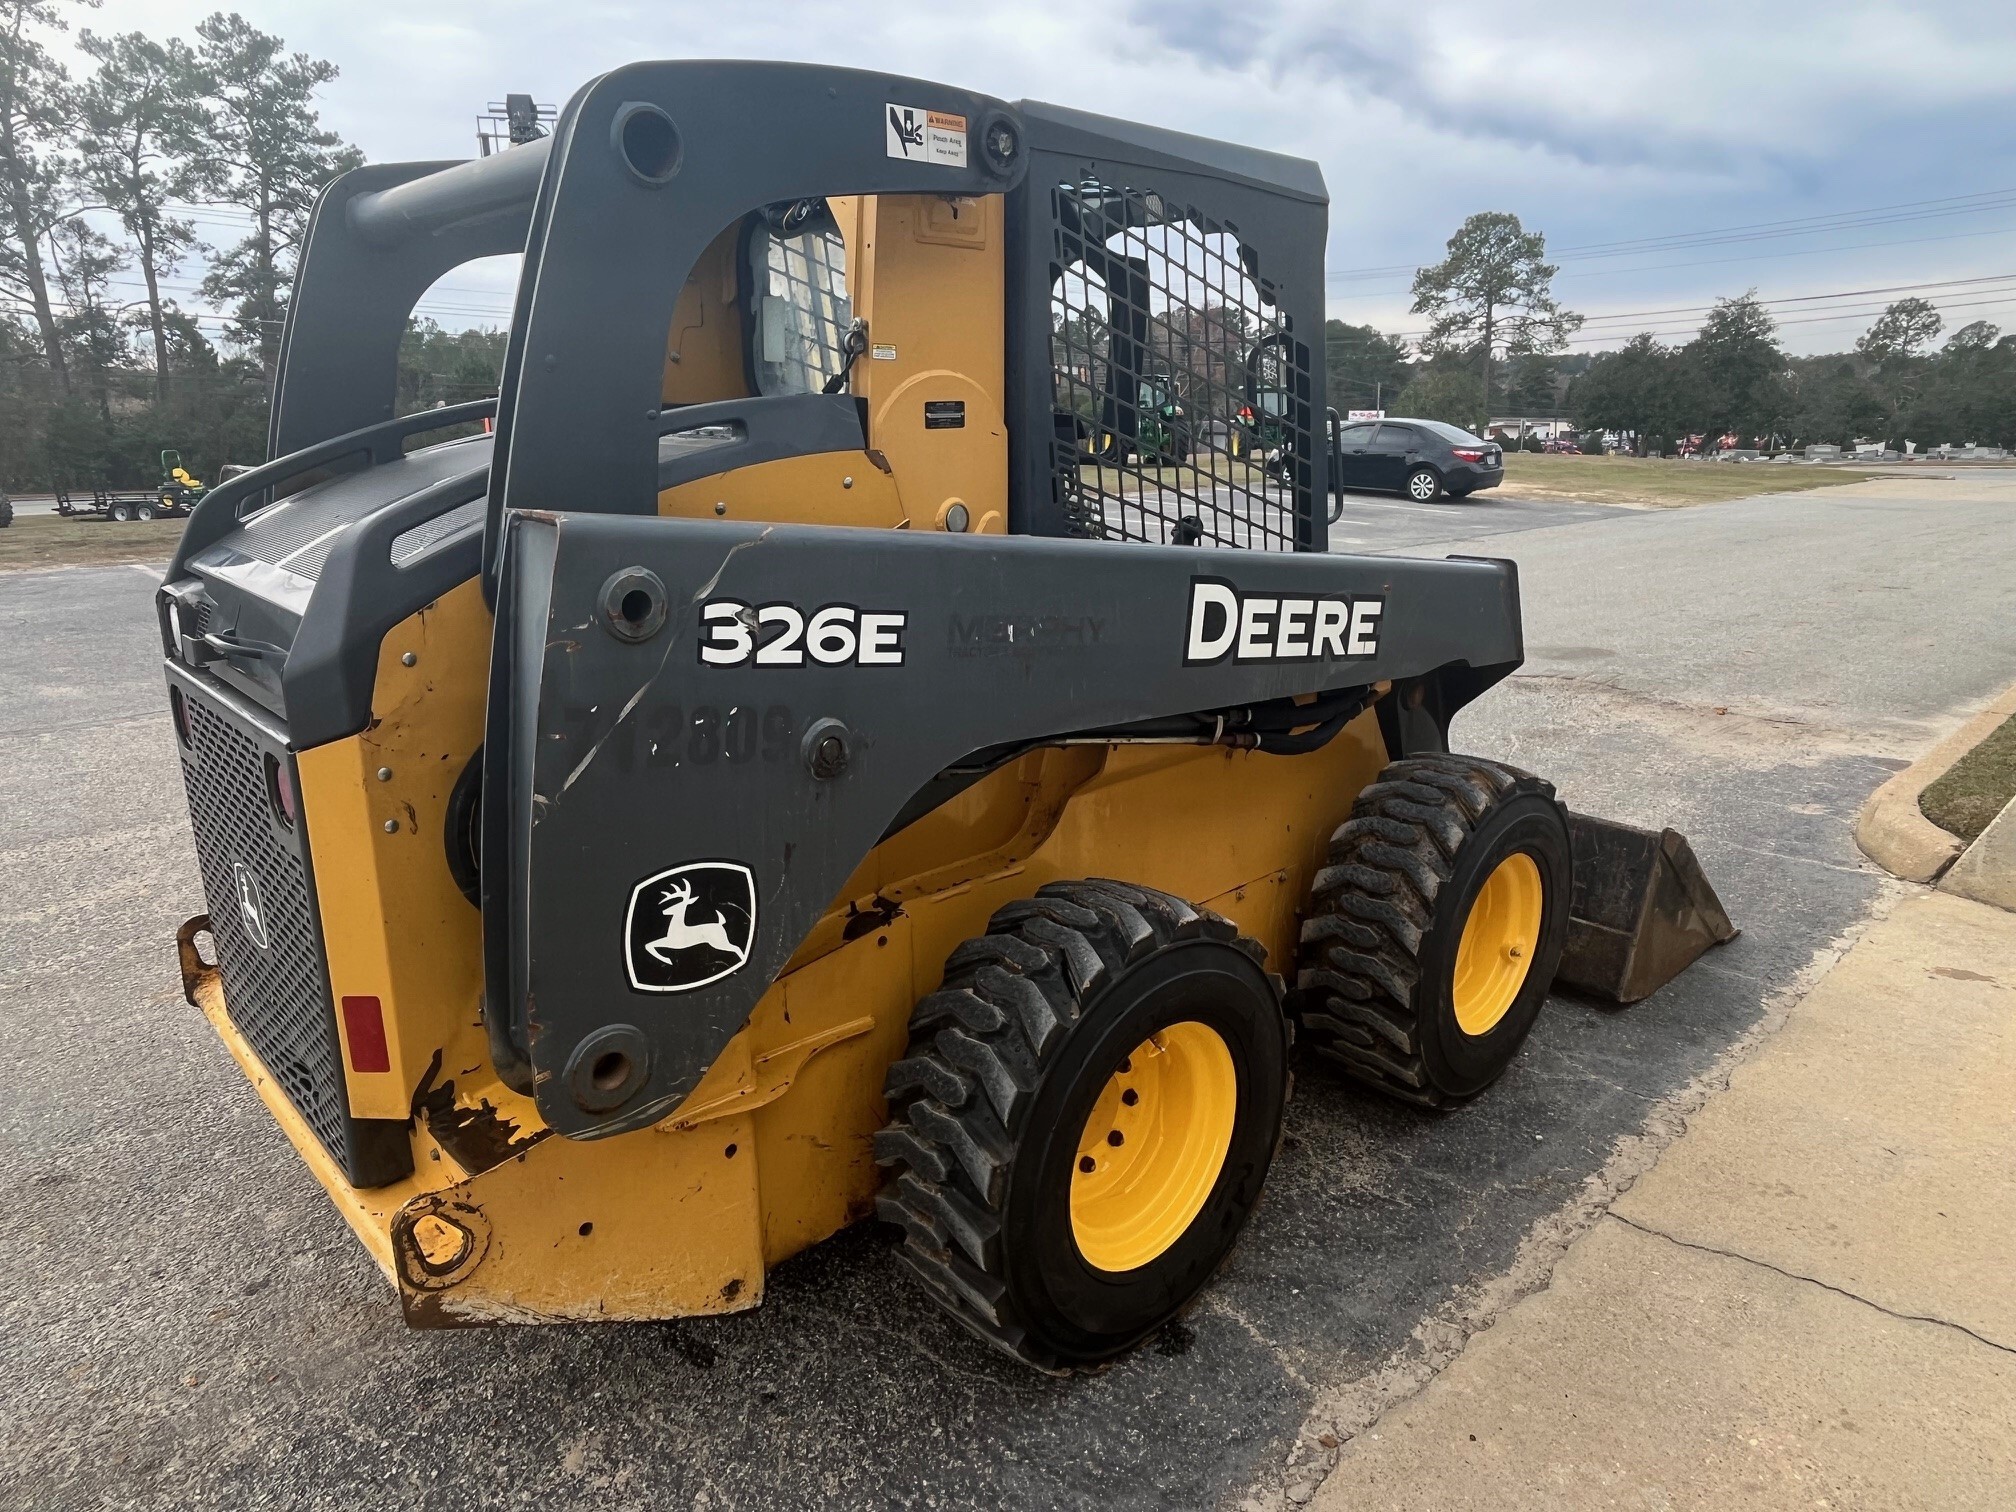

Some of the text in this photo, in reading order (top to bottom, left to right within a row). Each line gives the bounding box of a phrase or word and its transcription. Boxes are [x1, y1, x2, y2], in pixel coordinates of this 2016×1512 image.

[933, 134, 948, 143] Pinch
[934, 118, 963, 128] WARNING
[701, 602, 905, 664] 326E
[1187, 583, 1382, 660] DEERE
